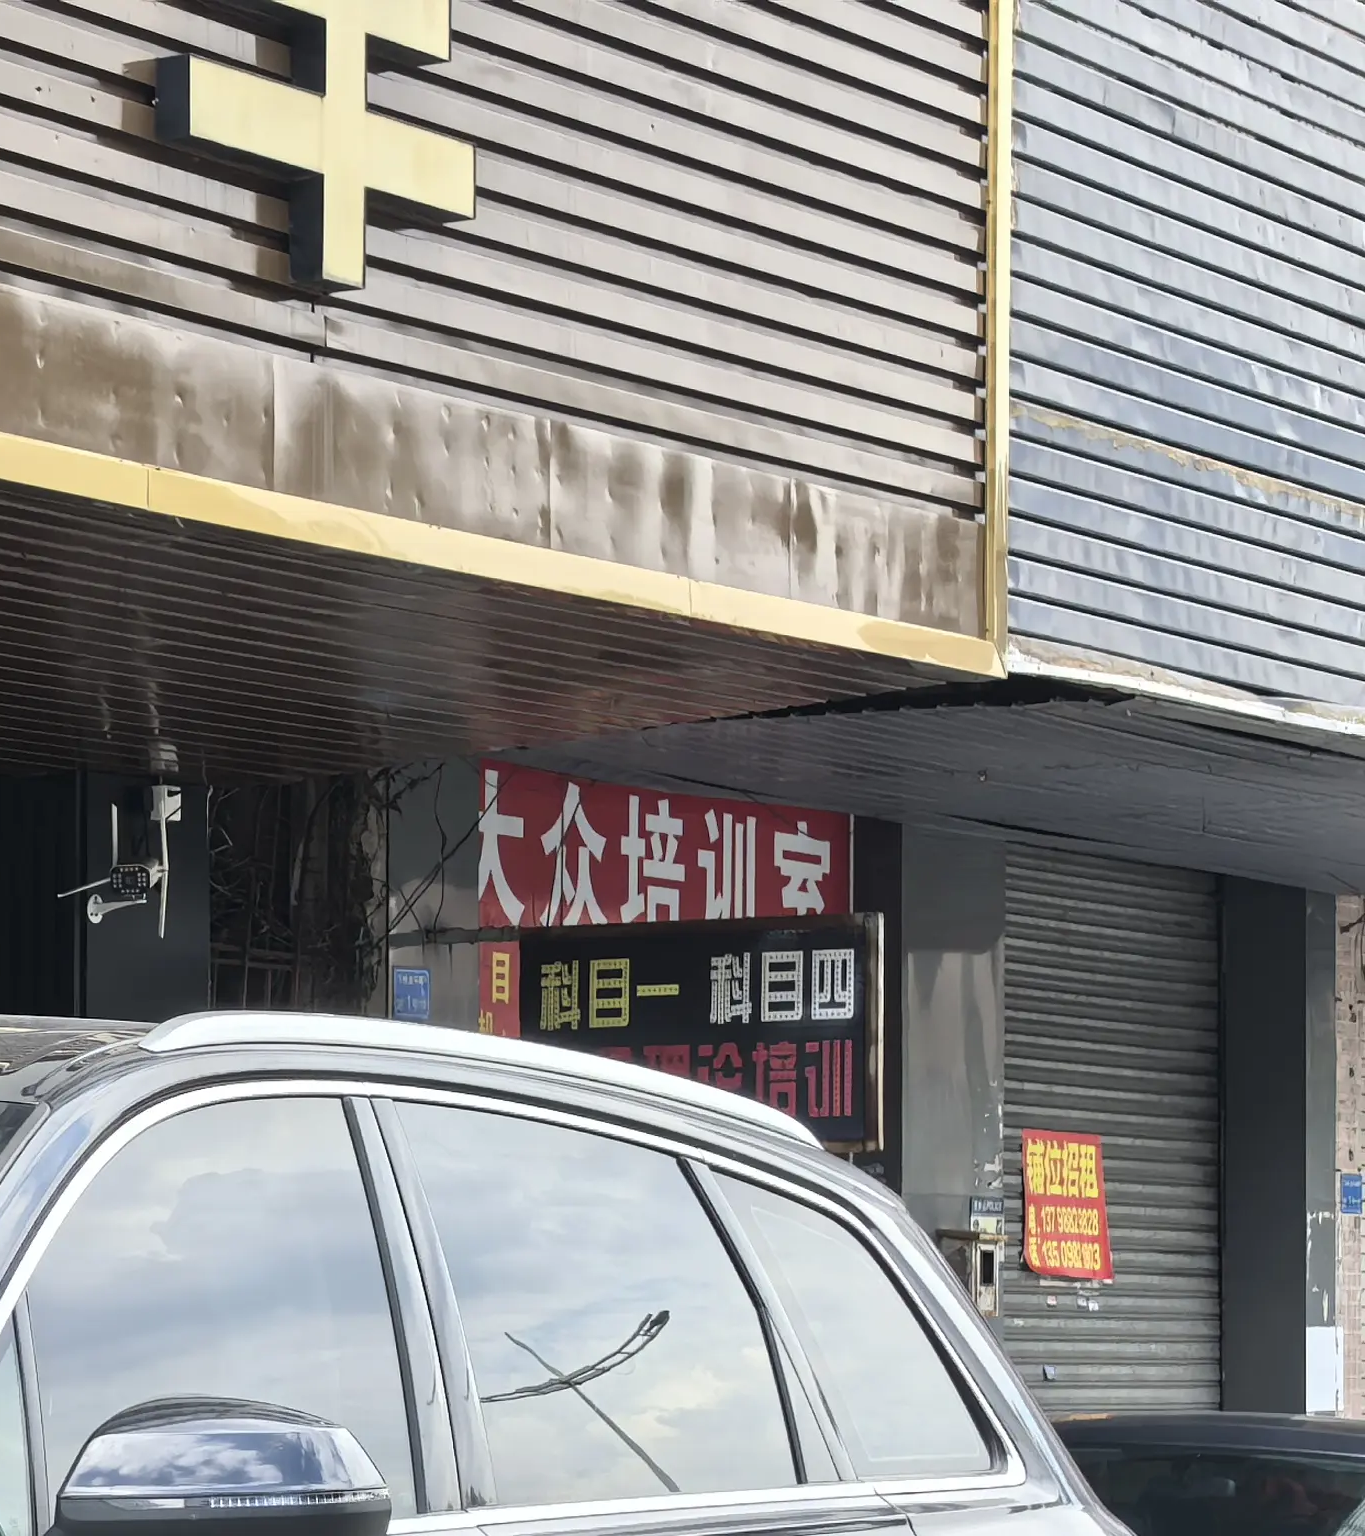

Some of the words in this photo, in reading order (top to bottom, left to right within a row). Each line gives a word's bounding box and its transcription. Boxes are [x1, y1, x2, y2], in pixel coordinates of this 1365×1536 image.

[540, 959, 679, 1030] 科目一
[710, 948, 855, 1025] 科目四
